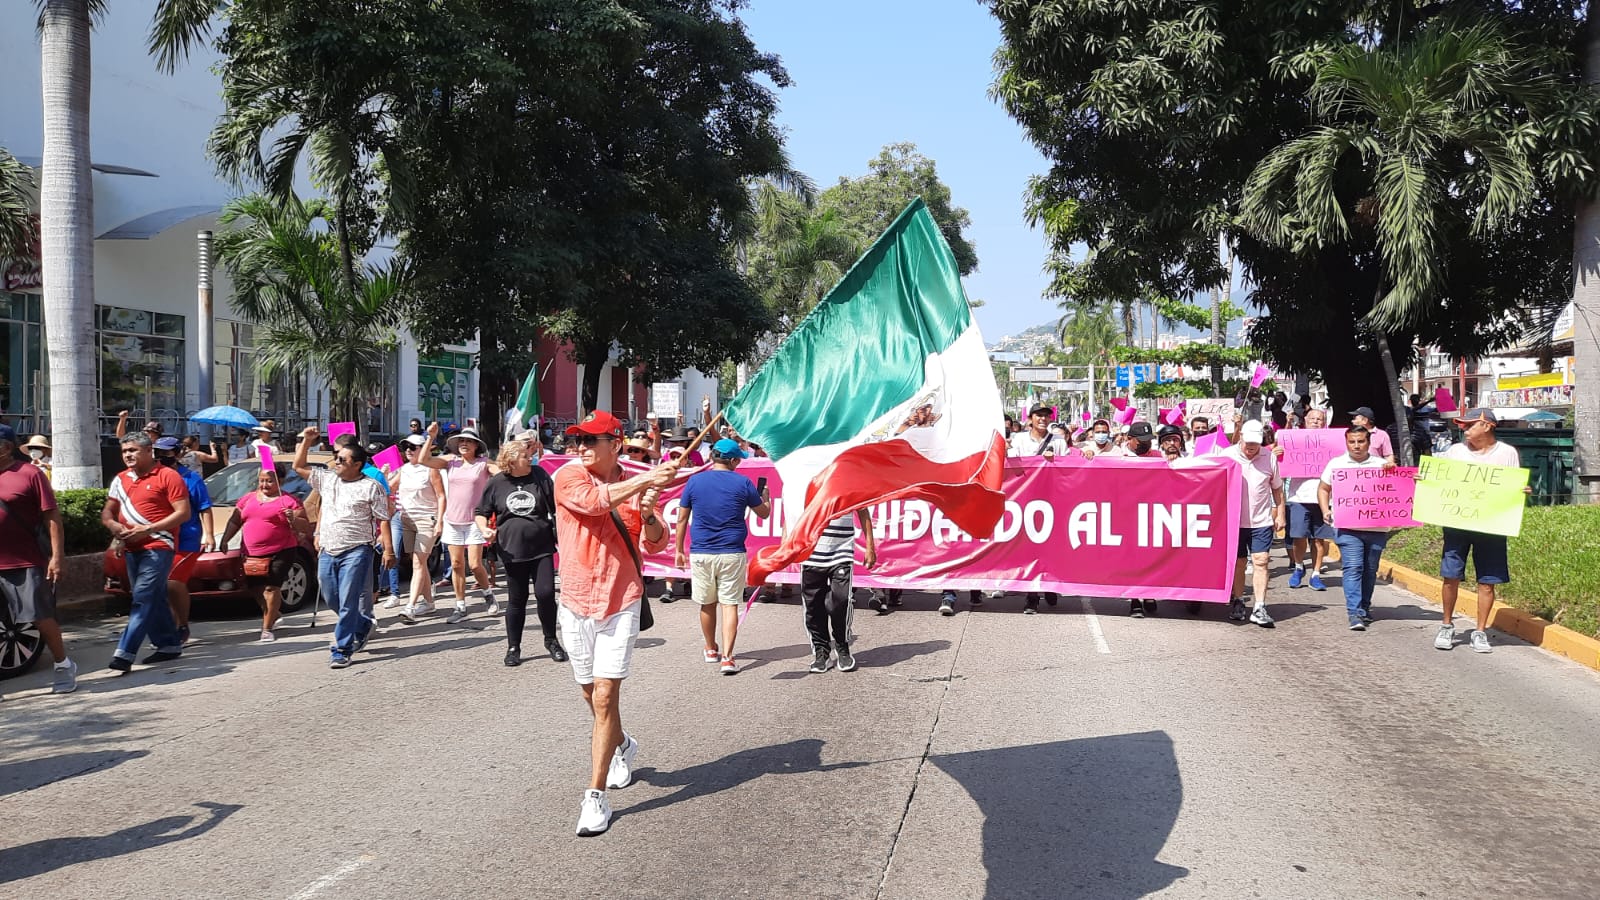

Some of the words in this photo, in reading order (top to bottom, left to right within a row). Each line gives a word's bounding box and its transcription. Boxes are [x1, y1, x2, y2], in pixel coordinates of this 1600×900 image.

[1283, 434, 1299, 450] EL
[1304, 434, 1328, 449] INE
[1461, 463, 1504, 486] INE
[1353, 484, 1367, 493] AL
[1373, 483, 1397, 492] INE
[1440, 488, 1459, 499] NO
[1337, 496, 1401, 508] PERDEMOS
[1406, 496, 1414, 505] A
[1441, 503, 1480, 520] TOCA
[1068, 501, 1123, 550] AL
[1137, 502, 1213, 549] INE
